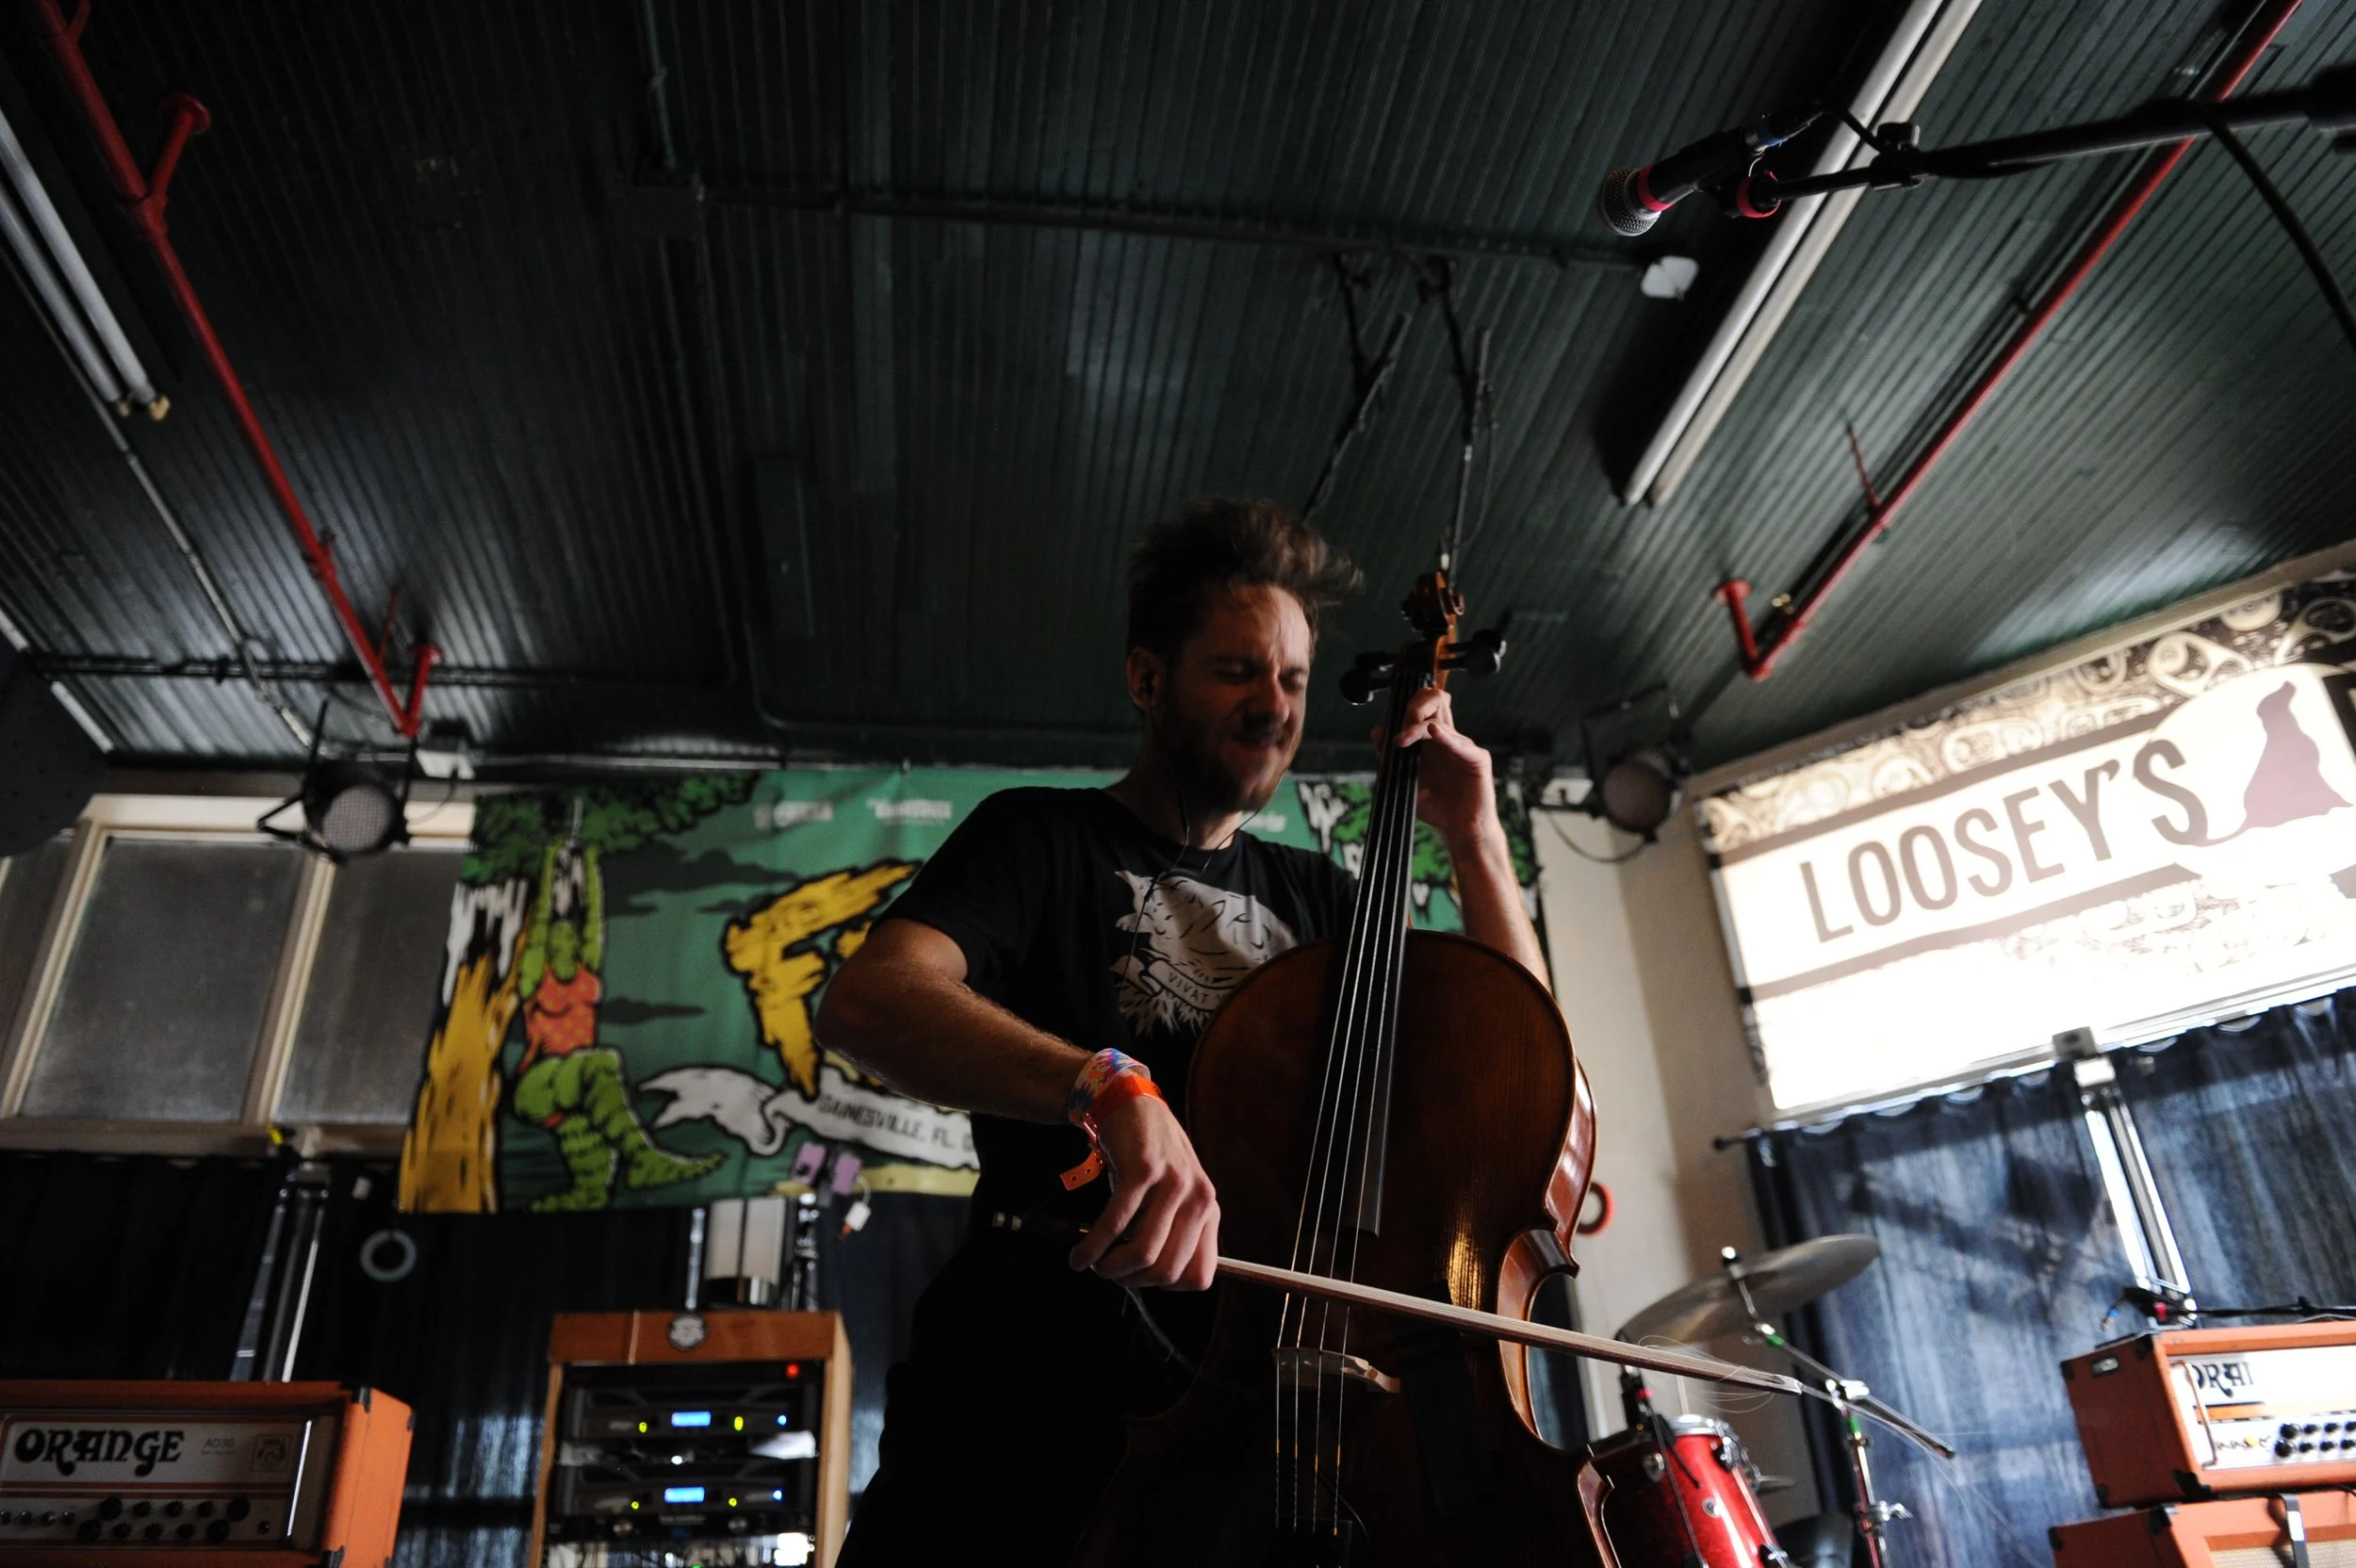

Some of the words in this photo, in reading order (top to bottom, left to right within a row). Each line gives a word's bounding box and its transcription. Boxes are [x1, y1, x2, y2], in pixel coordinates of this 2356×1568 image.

[1800, 739, 2208, 943] LOOSEY'S
[1168, 972, 1209, 1004] VIVAT
[14, 1428, 185, 1478] ORANGE
